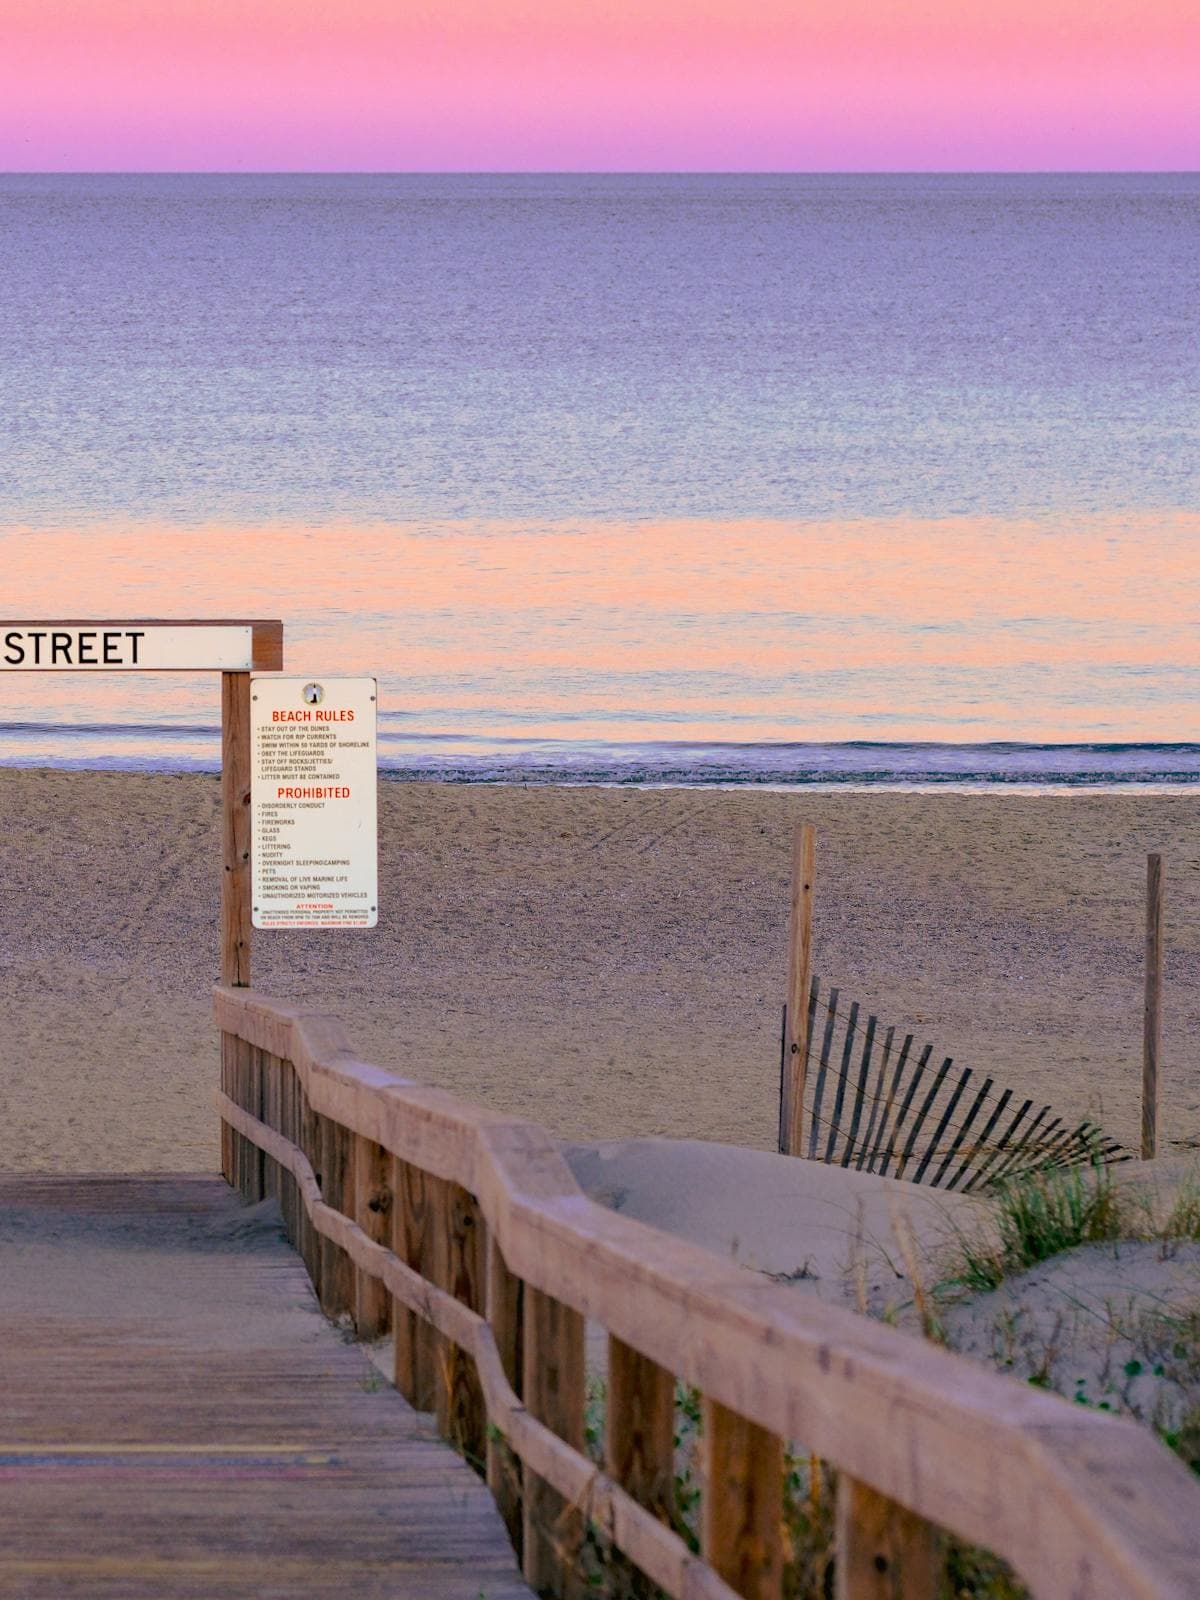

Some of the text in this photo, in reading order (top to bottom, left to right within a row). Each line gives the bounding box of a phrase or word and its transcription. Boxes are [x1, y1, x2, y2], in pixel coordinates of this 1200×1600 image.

[4, 632, 145, 664] STREET
[272, 711, 355, 721] BEACH RULES
[278, 787, 350, 798] PROHIBITED
